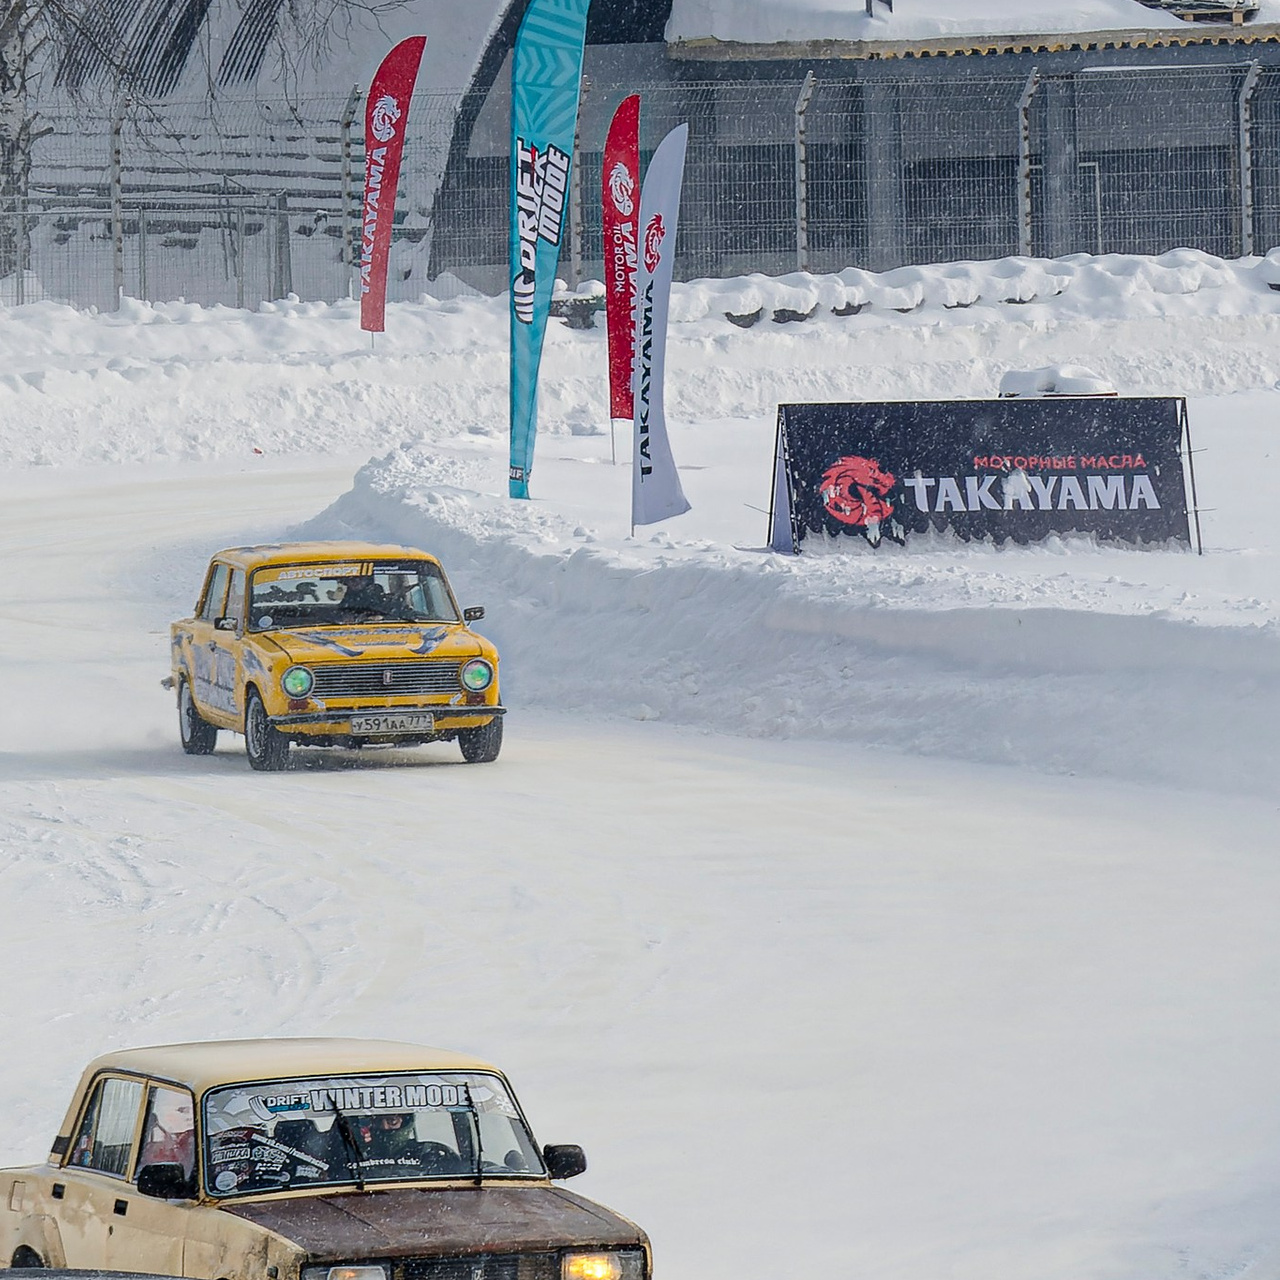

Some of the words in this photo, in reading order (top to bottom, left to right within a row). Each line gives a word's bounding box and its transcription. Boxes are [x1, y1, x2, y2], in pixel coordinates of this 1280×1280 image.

[516, 138, 538, 272] DRIFT
[538, 144, 570, 245] MODE
[360, 146, 387, 298] TAKAYAMA
[613, 221, 623, 244] OIL
[614, 246, 626, 292] MOTOR
[973, 455, 1077, 470] МОТОРНЫЕ
[1080, 454, 1148, 469] МАСЛА
[266, 1094, 309, 1108] DRIFT
[310, 1085, 403, 1112] WINTER
[404, 1083, 471, 1108] MODE
